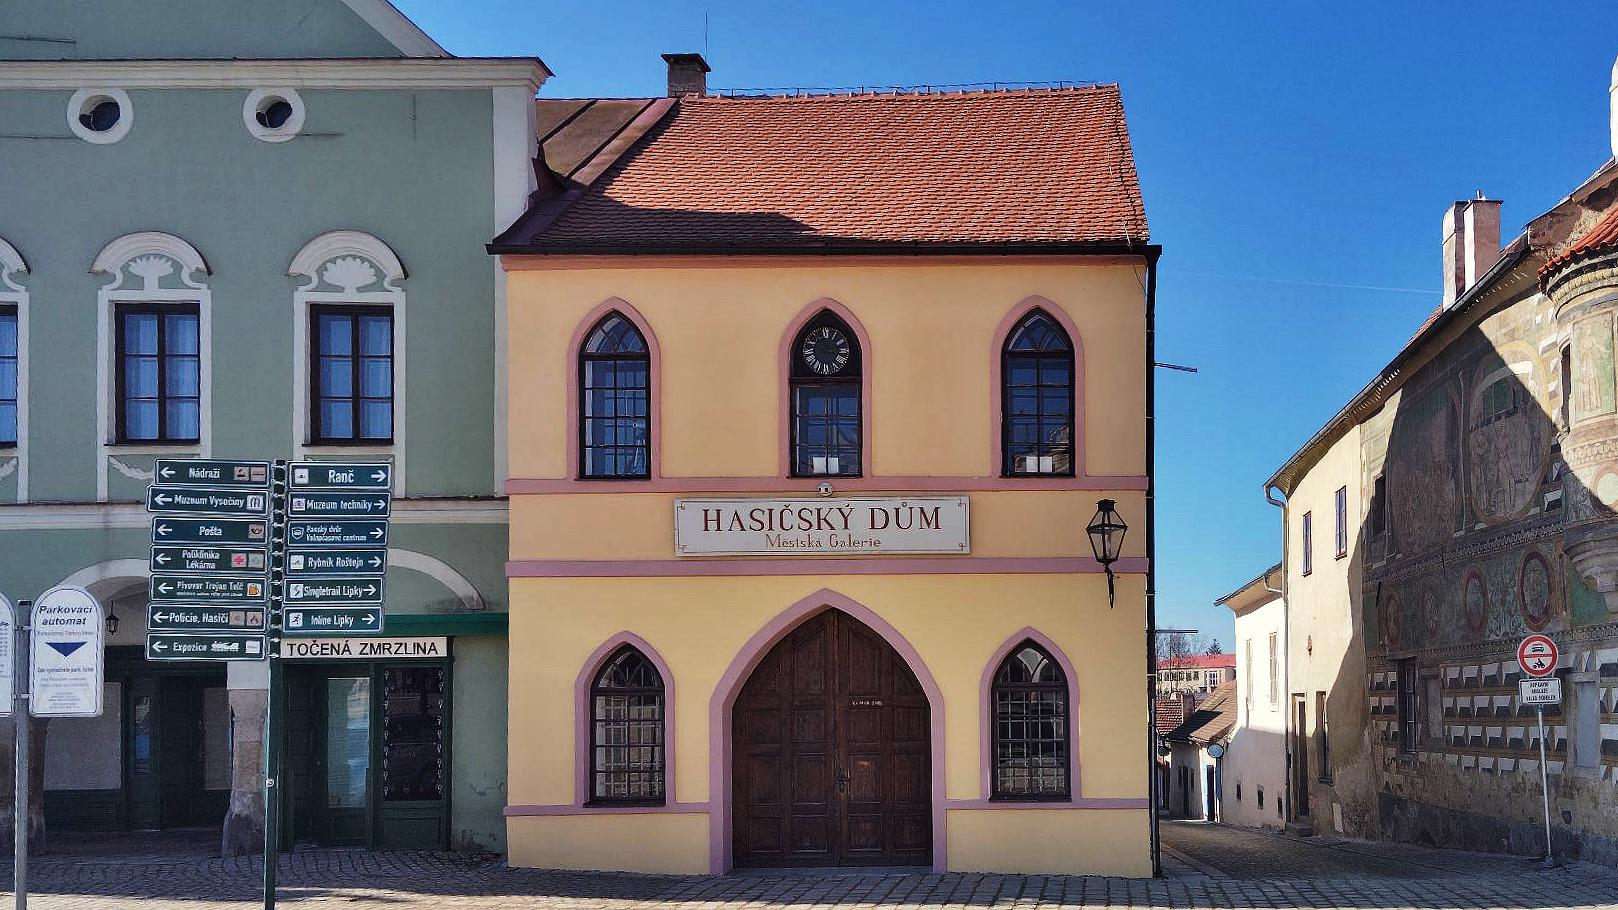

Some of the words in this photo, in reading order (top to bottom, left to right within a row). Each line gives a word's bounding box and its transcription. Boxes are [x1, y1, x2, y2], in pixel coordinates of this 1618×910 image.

[188, 468, 221, 479] Nádraží
[328, 469, 355, 483] Ranč
[174, 494, 207, 505] Muzeum
[209, 494, 245, 507] Vysočiny
[306, 499, 337, 510] Muzeum
[340, 499, 373, 512] techniky
[702, 503, 856, 532] HASIČSKÝ
[869, 501, 942, 531] DŮM
[199, 526, 222, 536] Pošta
[829, 533, 881, 548] Galerie
[182, 550, 220, 560] Poliklinika
[186, 560, 216, 569] Lékárna
[308, 557, 334, 569] Rybník
[336, 557, 364, 569] Roštejn
[177, 581, 203, 590] Pivovar
[205, 581, 227, 592] Trojan
[304, 585, 341, 598] Singletrail
[342, 585, 363, 597] Lipky
[42, 617, 87, 626] automat
[169, 612, 201, 624] Policie,
[202, 612, 229, 623] Hasiči
[311, 615, 332, 625] Inline
[334, 615, 354, 627] Lipky
[173, 642, 208, 653] Expozice
[287, 639, 352, 656] TOČENÁ
[359, 641, 438, 656] ZMRZLINA
